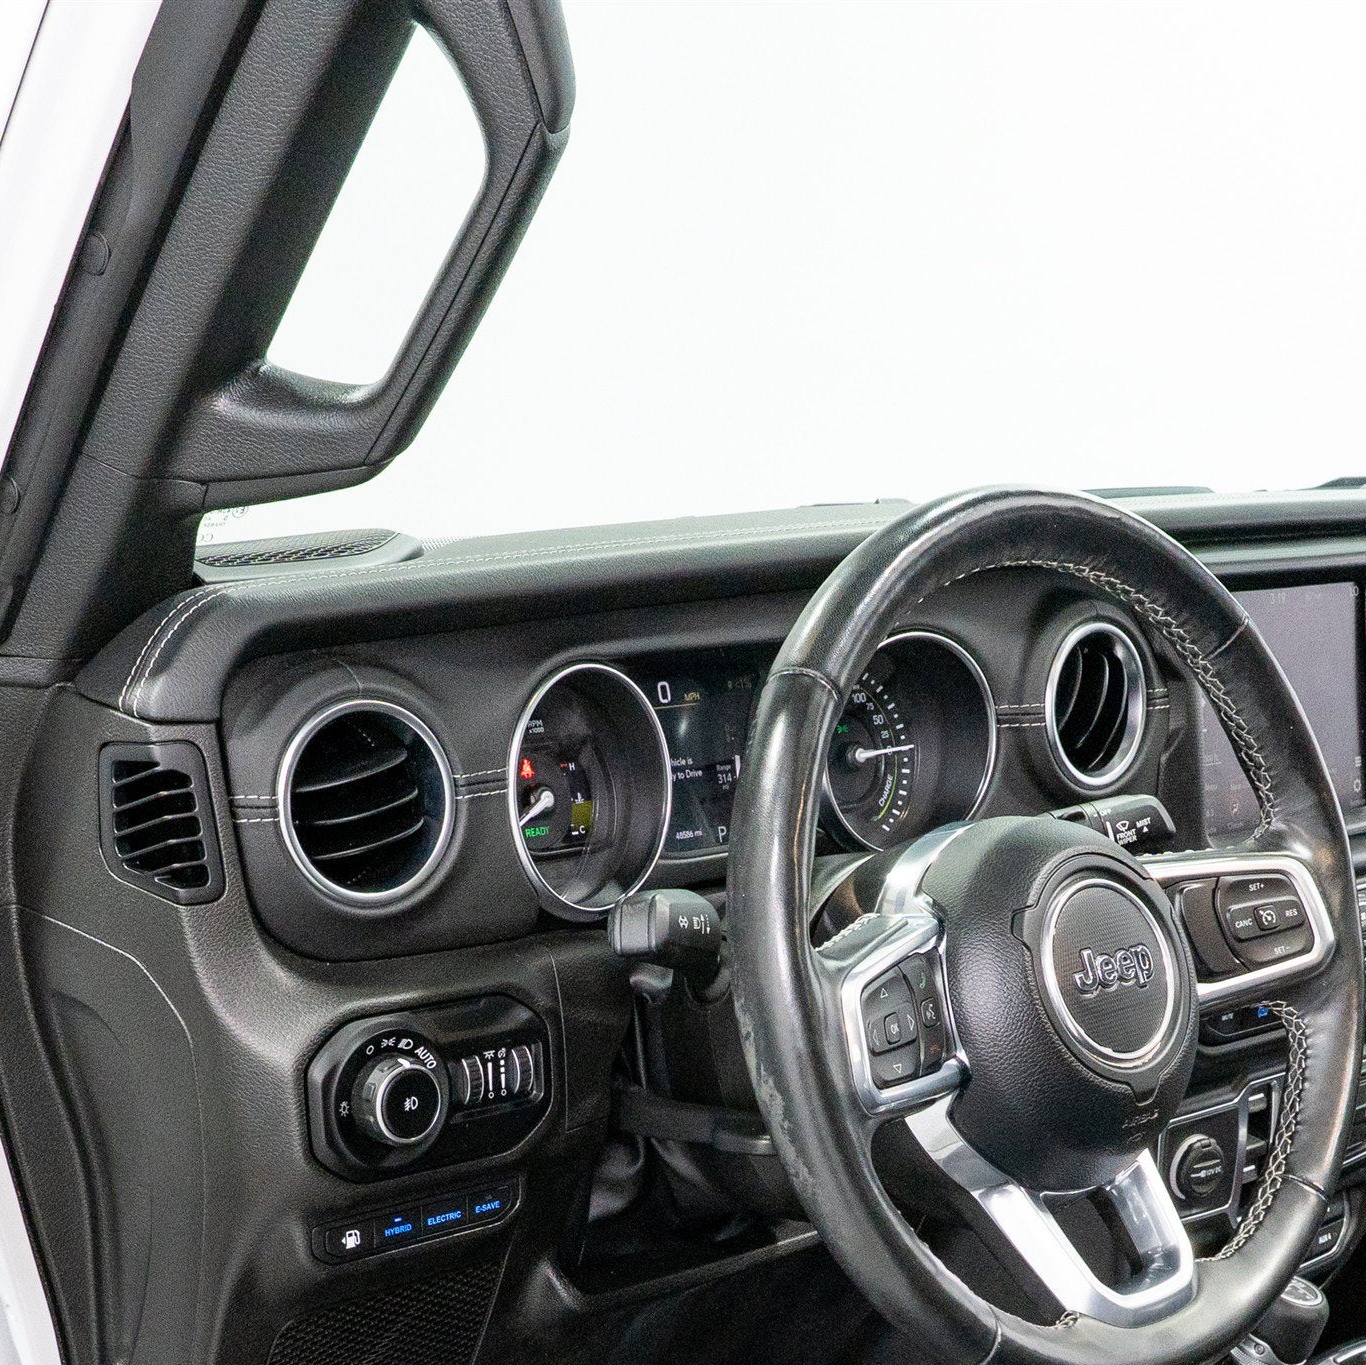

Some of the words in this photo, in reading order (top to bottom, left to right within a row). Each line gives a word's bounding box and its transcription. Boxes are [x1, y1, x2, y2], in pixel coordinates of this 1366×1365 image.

[683, 692, 701, 701] MPH
[852, 692, 867, 704] 100
[866, 702, 875, 711] 75
[527, 720, 544, 728] RPM
[872, 714, 884, 725] 50
[881, 730, 889, 739] 25
[568, 762, 576, 771] H
[685, 769, 703, 779] Drive
[717, 772, 733, 784] 314
[878, 774, 894, 807] CHARGE
[1136, 817, 1151, 828] MIST
[525, 826, 549, 838] READY
[579, 825, 586, 834] C
[718, 826, 727, 843] P
[1116, 828, 1137, 840] FRONT
[1248, 882, 1265, 892] SET+
[1235, 918, 1253, 928] CANC
[1285, 908, 1298, 917] RES
[1073, 944, 1155, 994] Jeep
[890, 1022, 900, 1034] OK
[414, 1046, 436, 1069] AUTO
[384, 1223, 413, 1237] HYBRID
[427, 1210, 462, 1226] ELECTRIC
[475, 1200, 501, 1214] E-SAVE
